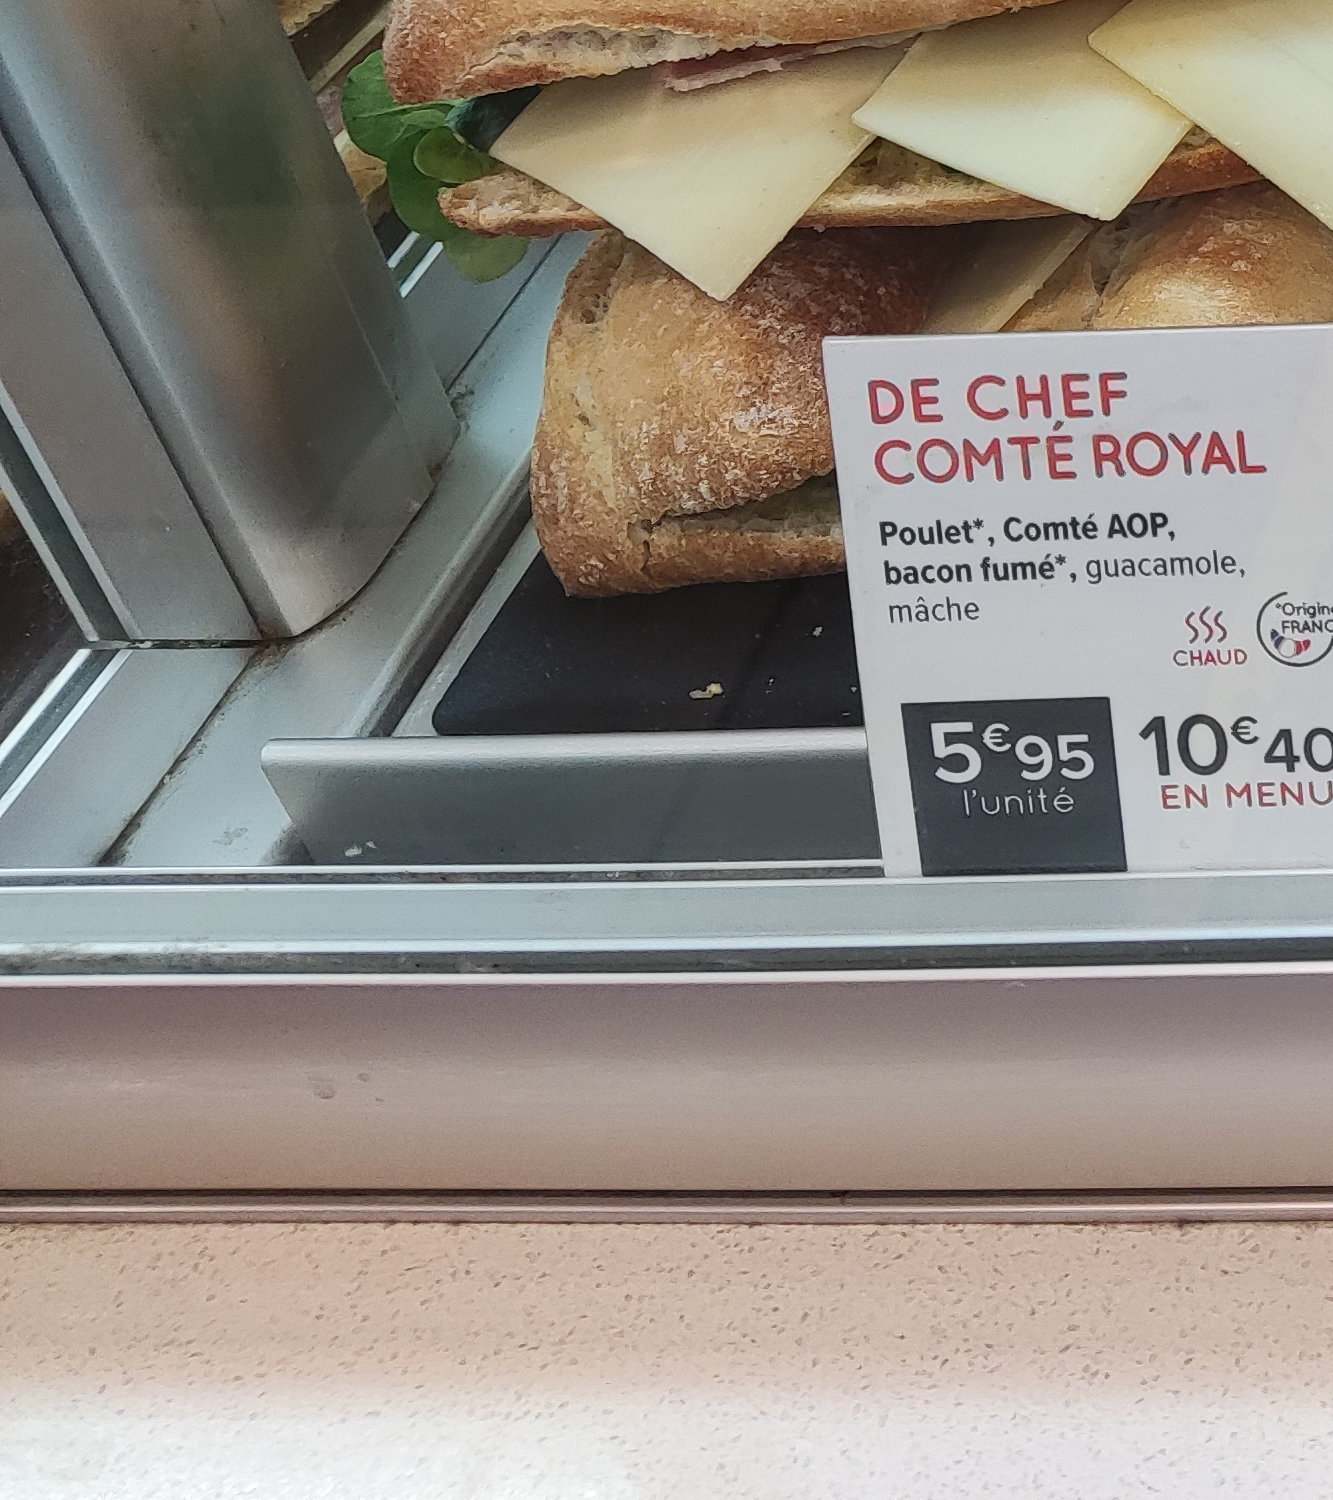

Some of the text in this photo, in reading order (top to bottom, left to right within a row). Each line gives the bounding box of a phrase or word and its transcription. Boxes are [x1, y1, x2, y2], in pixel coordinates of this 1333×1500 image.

[867, 372, 1129, 425] DE CHEF
[874, 421, 1267, 485] COMTÉ ROYAL
[1002, 515, 1099, 544] Comté
[1106, 512, 1177, 542] AOP,
[884, 561, 973, 585] bacon
[1085, 549, 1246, 584] guacamole,
[888, 595, 980, 623] mâche
[1172, 649, 1248, 667] CHAUD
[964, 786, 1075, 816] l'unité
[1161, 784, 1208, 809] EN
